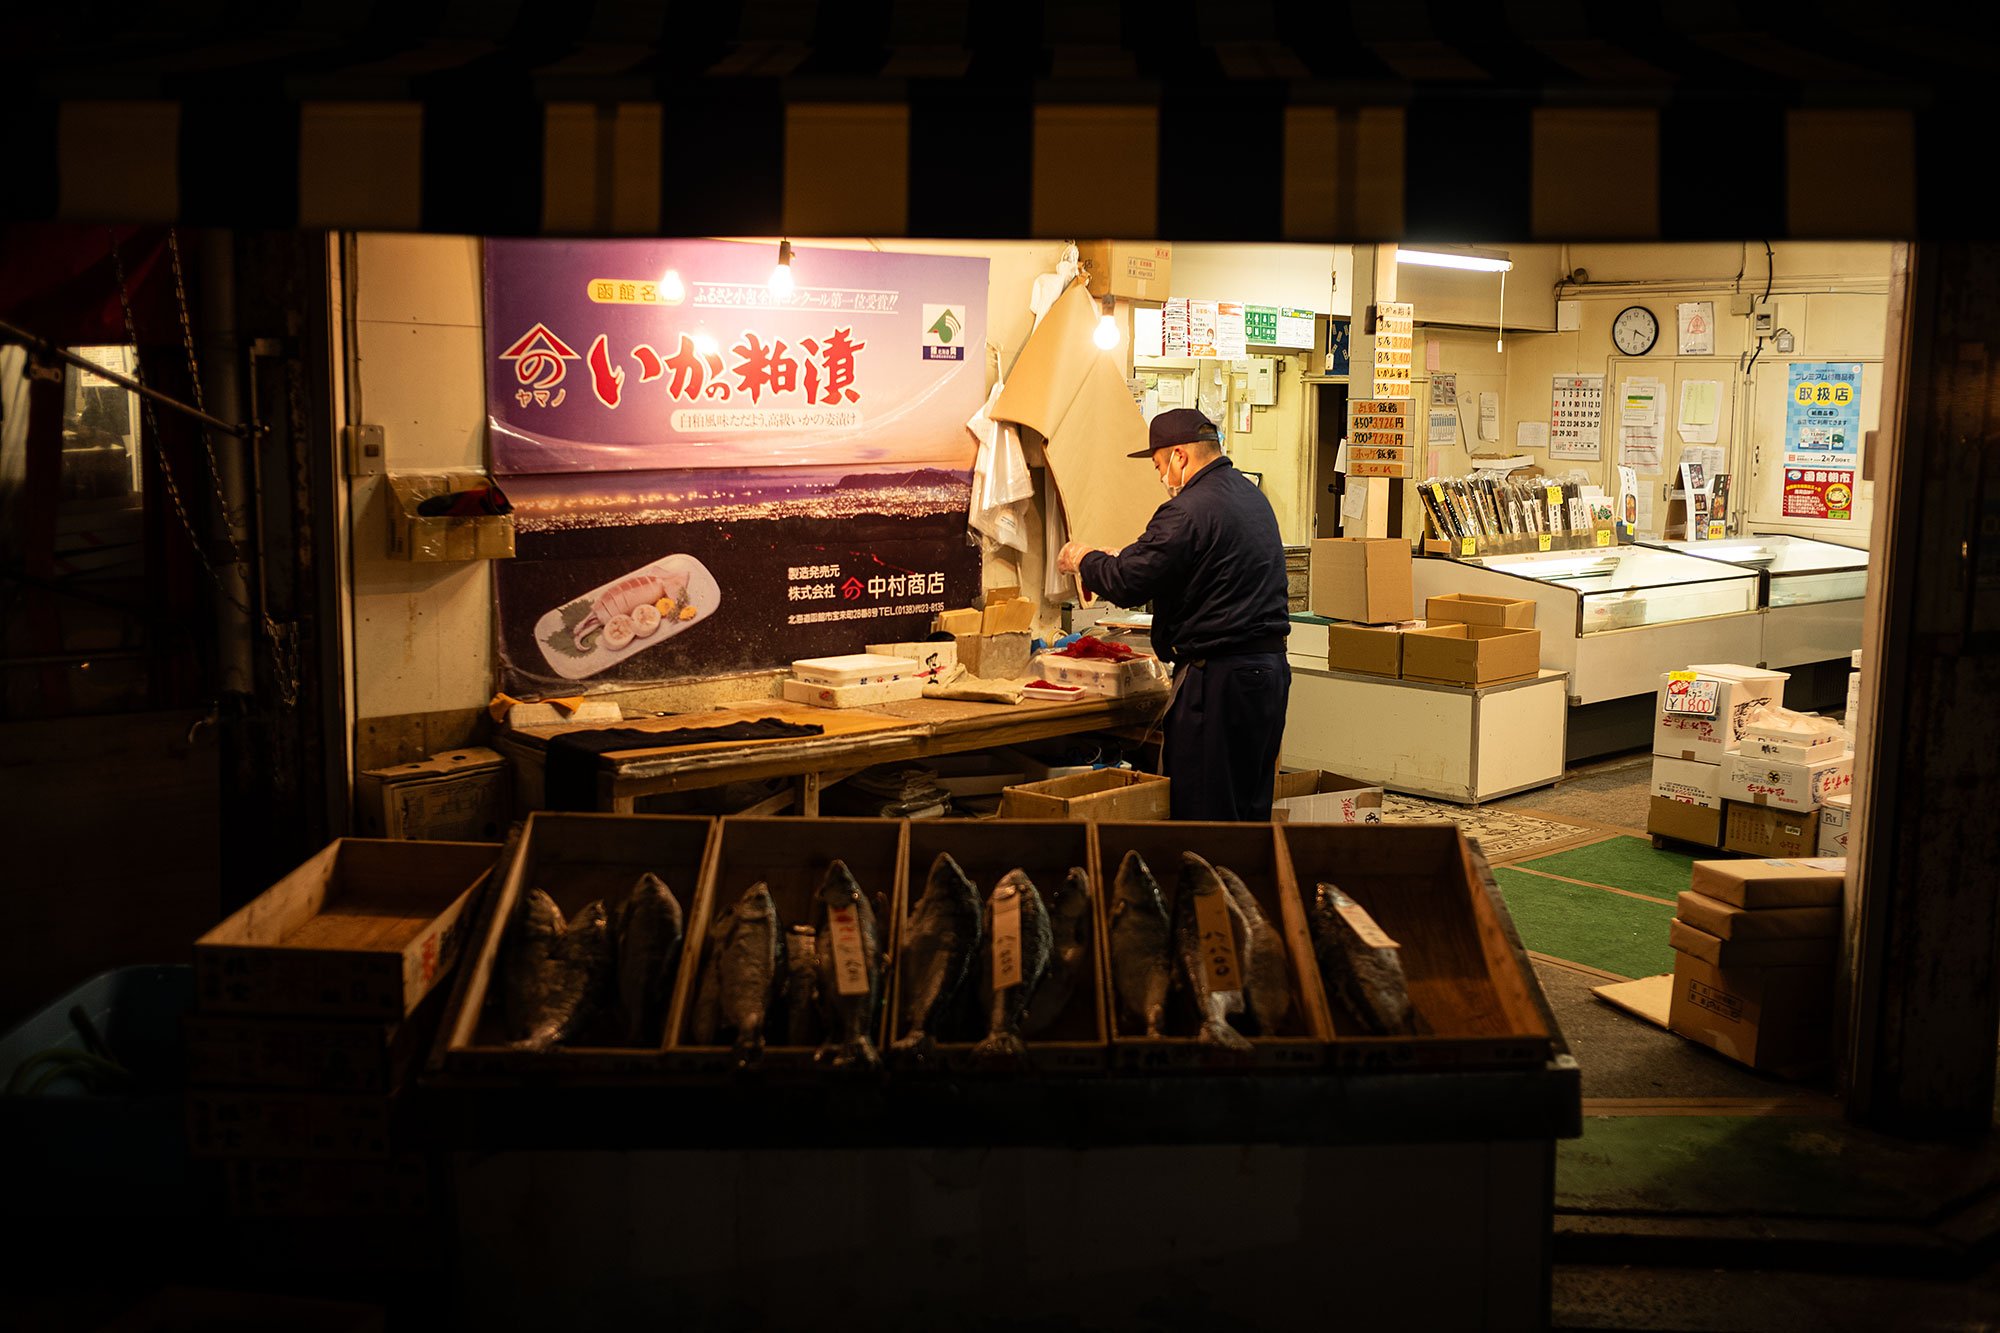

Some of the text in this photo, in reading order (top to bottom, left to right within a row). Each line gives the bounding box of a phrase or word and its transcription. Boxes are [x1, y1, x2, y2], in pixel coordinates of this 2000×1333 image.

[597, 283, 680, 302] 函館名
[515, 388, 567, 408] ヤマノ
[1800, 387, 1848, 400] 取扱店
[788, 564, 840, 580] 製造発売元
[788, 583, 836, 601] 株式会社
[867, 571, 945, 600] 中村商店
